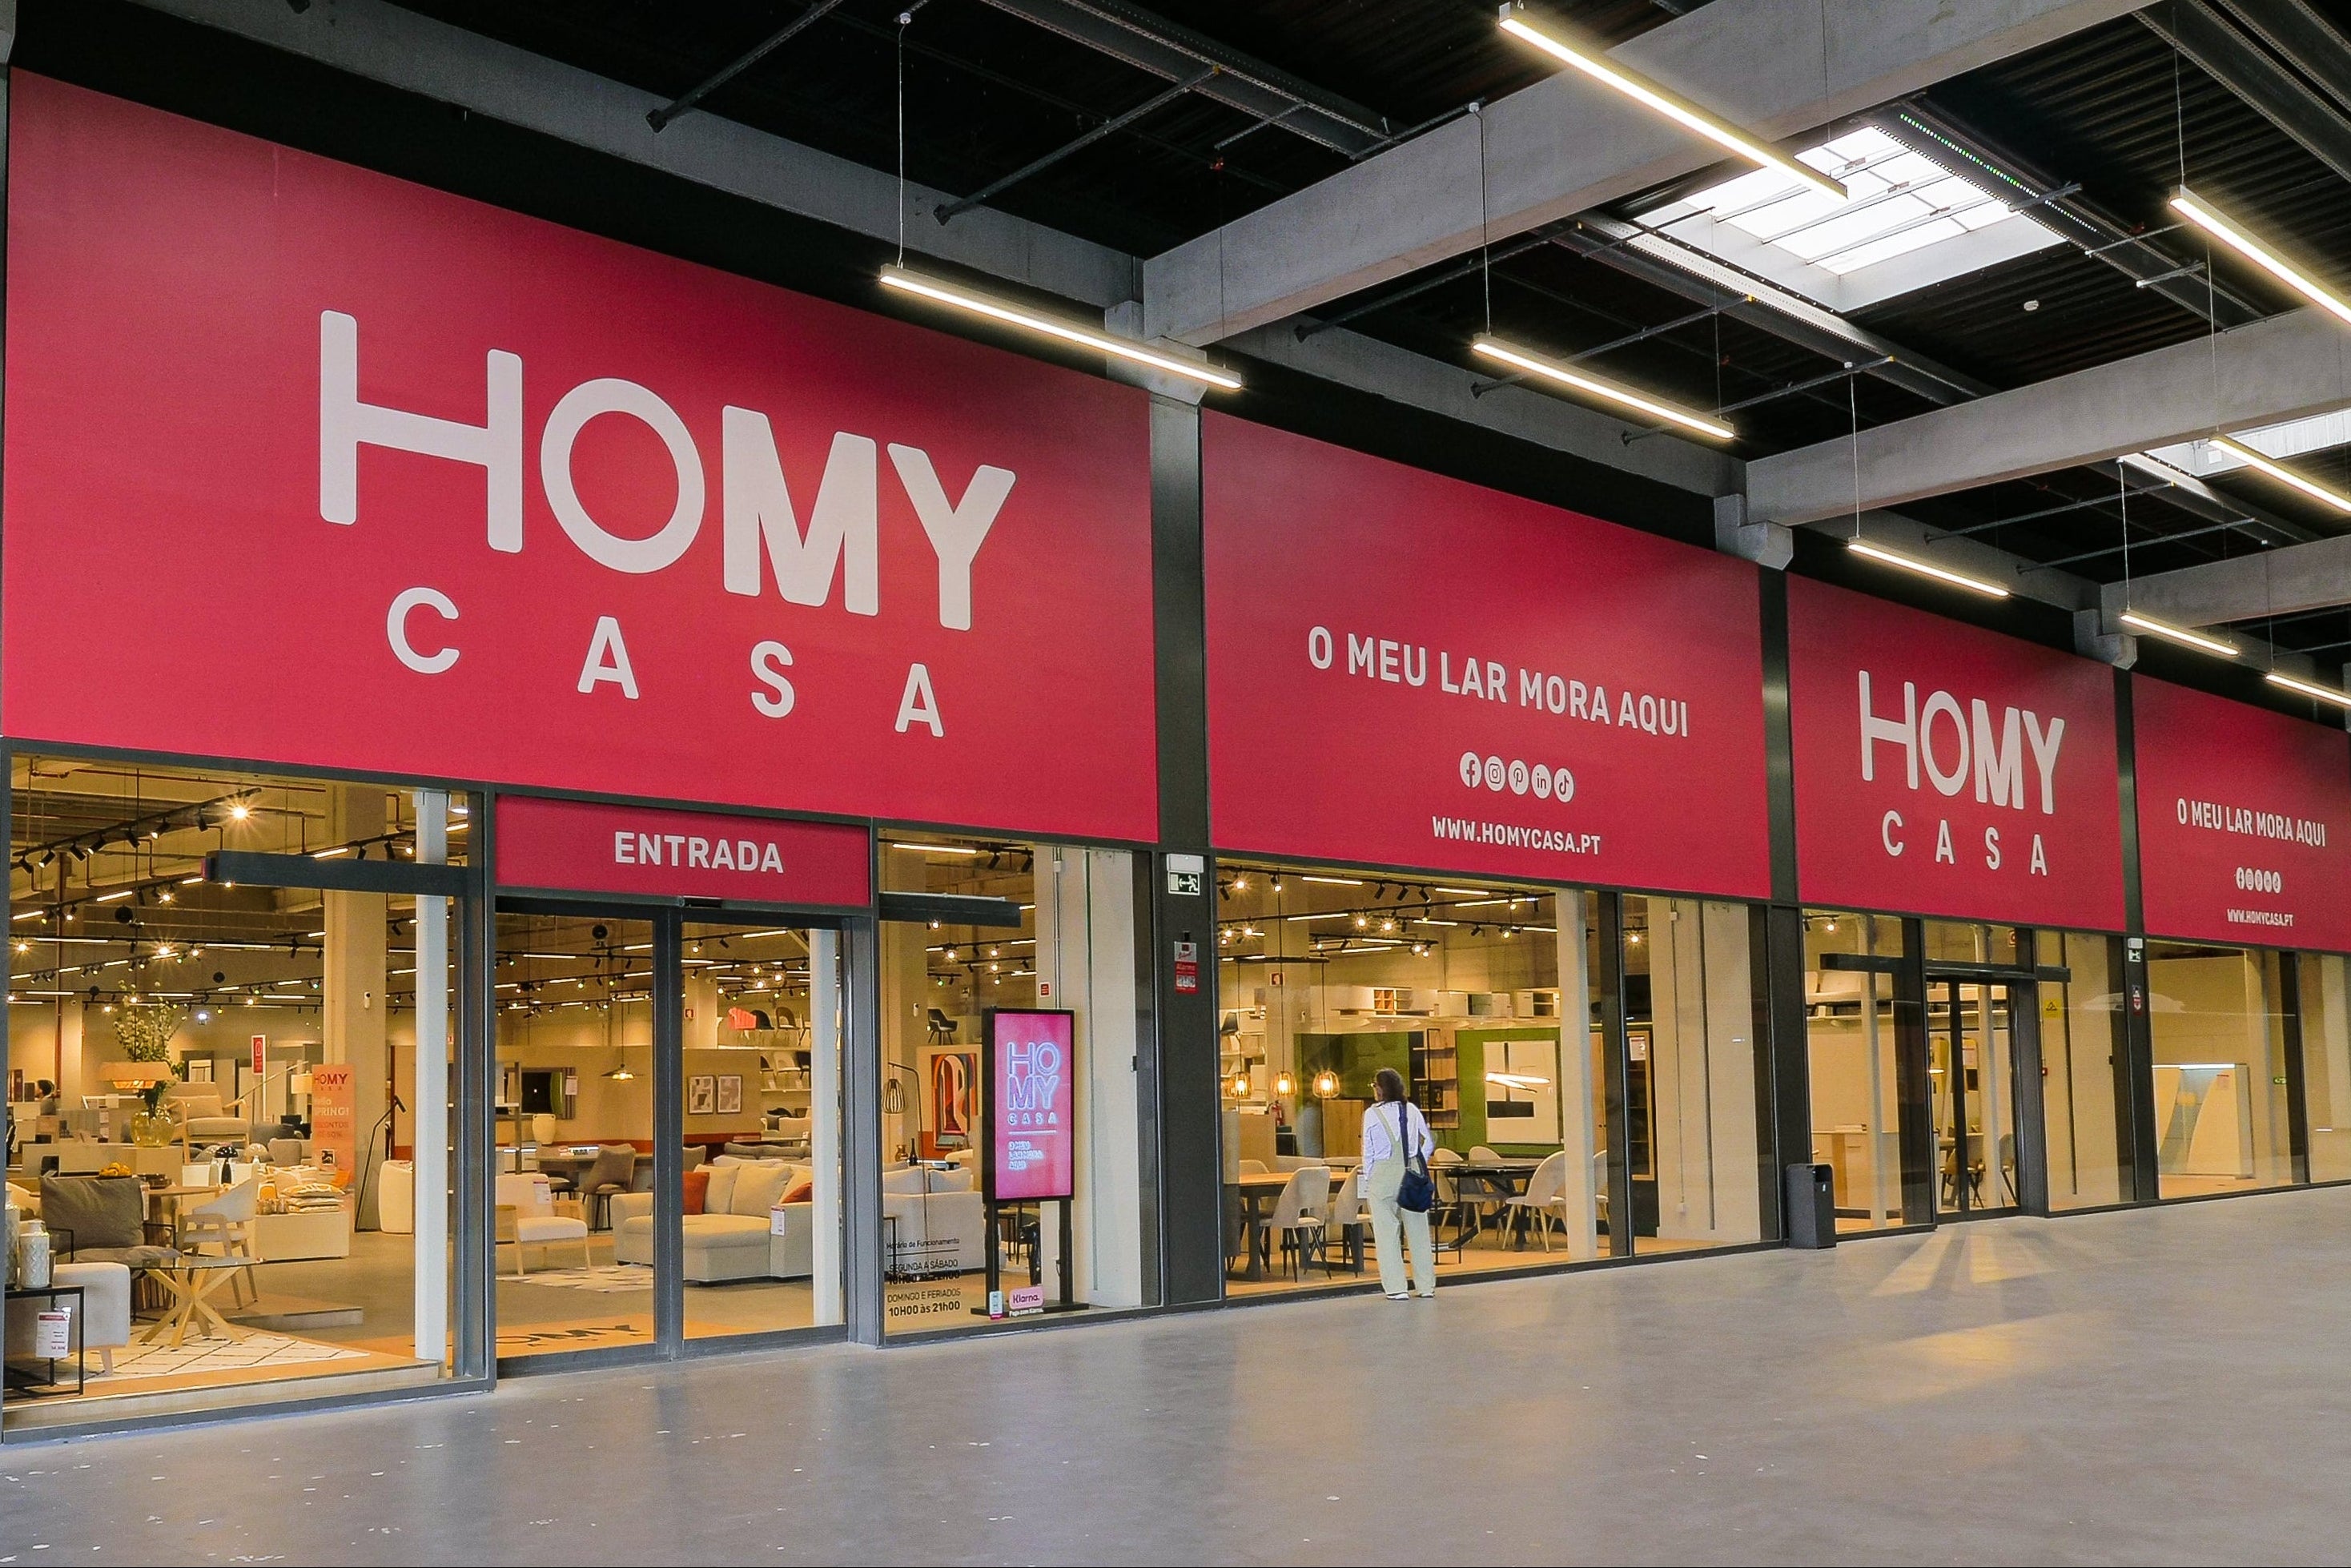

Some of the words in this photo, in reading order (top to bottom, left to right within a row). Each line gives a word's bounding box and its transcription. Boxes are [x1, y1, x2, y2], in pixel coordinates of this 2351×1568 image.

[319, 309, 1017, 632] HOMY
[386, 585, 945, 738] CASA
[1309, 627, 1332, 669] O
[1348, 633, 1425, 685] MEU
[1441, 652, 1506, 702] LAR
[1521, 669, 1610, 724] MORA
[1618, 692, 1687, 737] AQUI
[1859, 669, 2065, 814] HOMY
[1433, 817, 1600, 854] WWW.HOMYCASA.PT
[2178, 798, 2187, 824] O
[2192, 801, 2221, 829] MEU
[2226, 806, 2253, 834] LAR
[2257, 812, 2293, 840] MORA
[2297, 819, 2325, 846] AQUI
[616, 832, 783, 873] ENTRADA
[1882, 810, 2048, 876] CASA
[2228, 909, 2293, 926] WWW.HOMYCASA.PT
[1008, 1112, 1058, 1125] CASA
[886, 1241, 907, 1249] Hário
[887, 1292, 920, 1303] DOMINGO
[922, 1292, 926, 1300] E
[927, 1288, 961, 1299] FERIADOS
[889, 1305, 918, 1317] 10H00
[920, 1304, 930, 1313] às
[932, 1301, 960, 1312] 21h00
